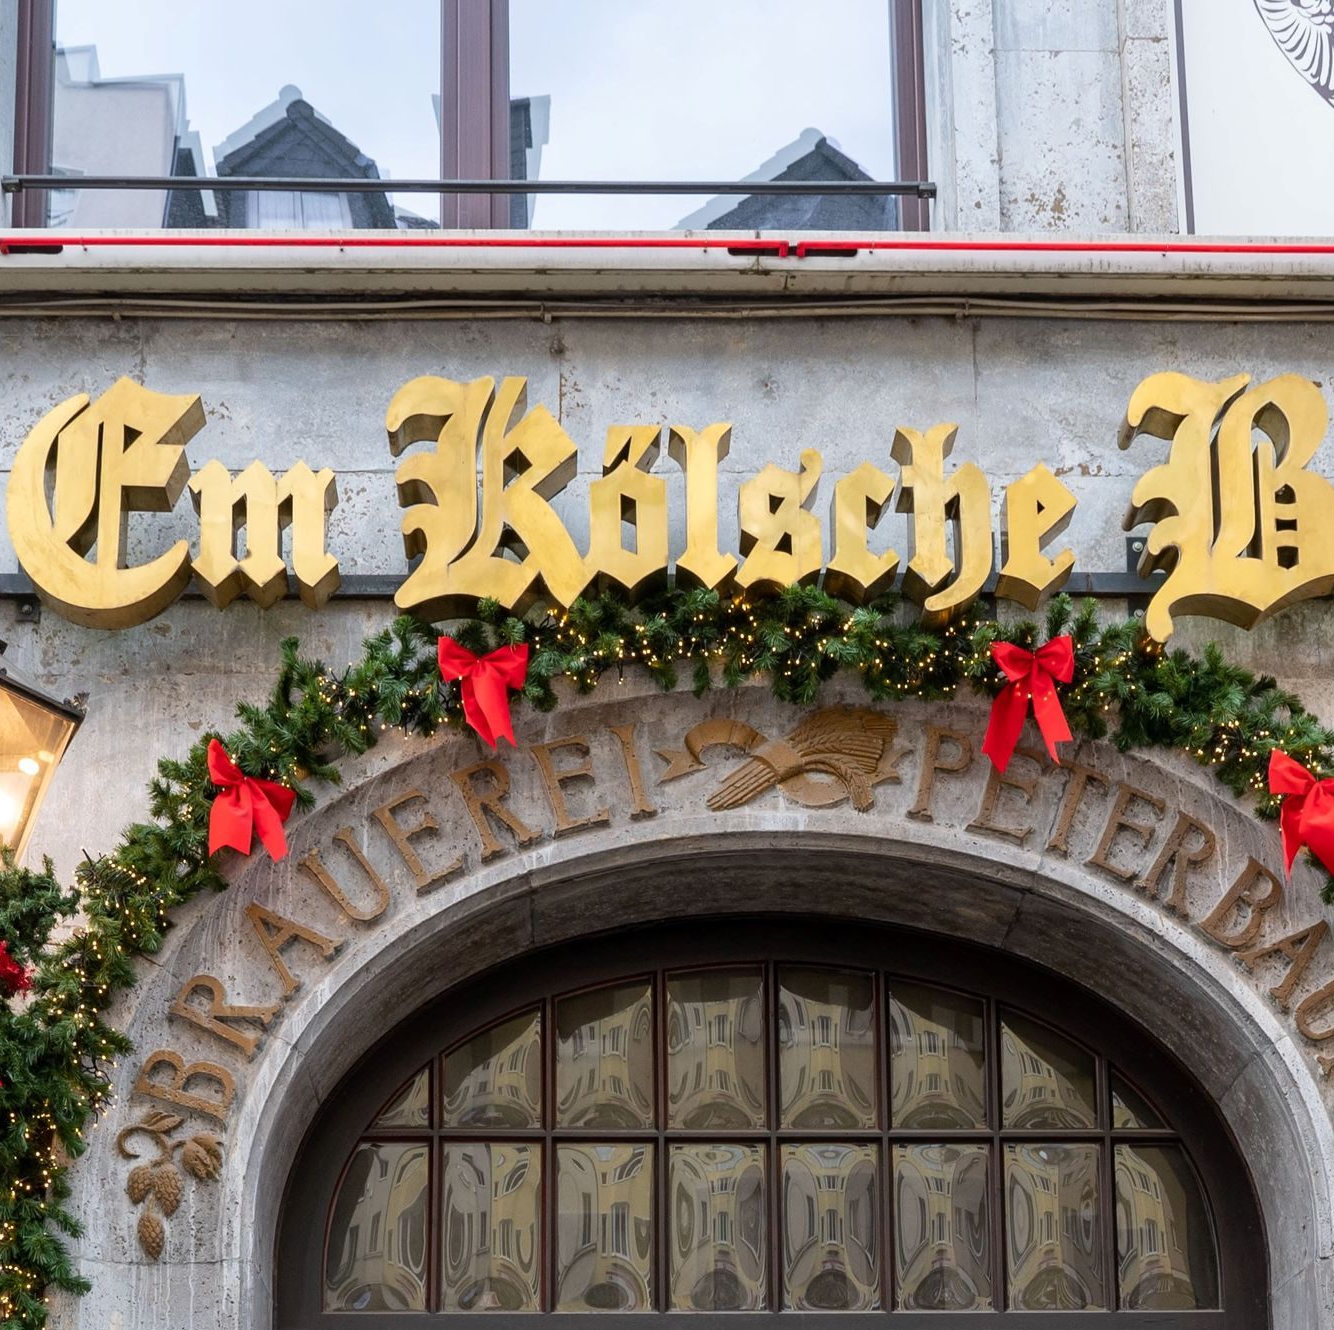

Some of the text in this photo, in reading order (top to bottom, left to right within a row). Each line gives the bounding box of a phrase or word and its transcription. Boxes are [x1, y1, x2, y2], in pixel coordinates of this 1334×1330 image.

[5, 375, 339, 628] Em
[386, 373, 1079, 626] Kölsche
[133, 723, 657, 1126] BRAUEREI
